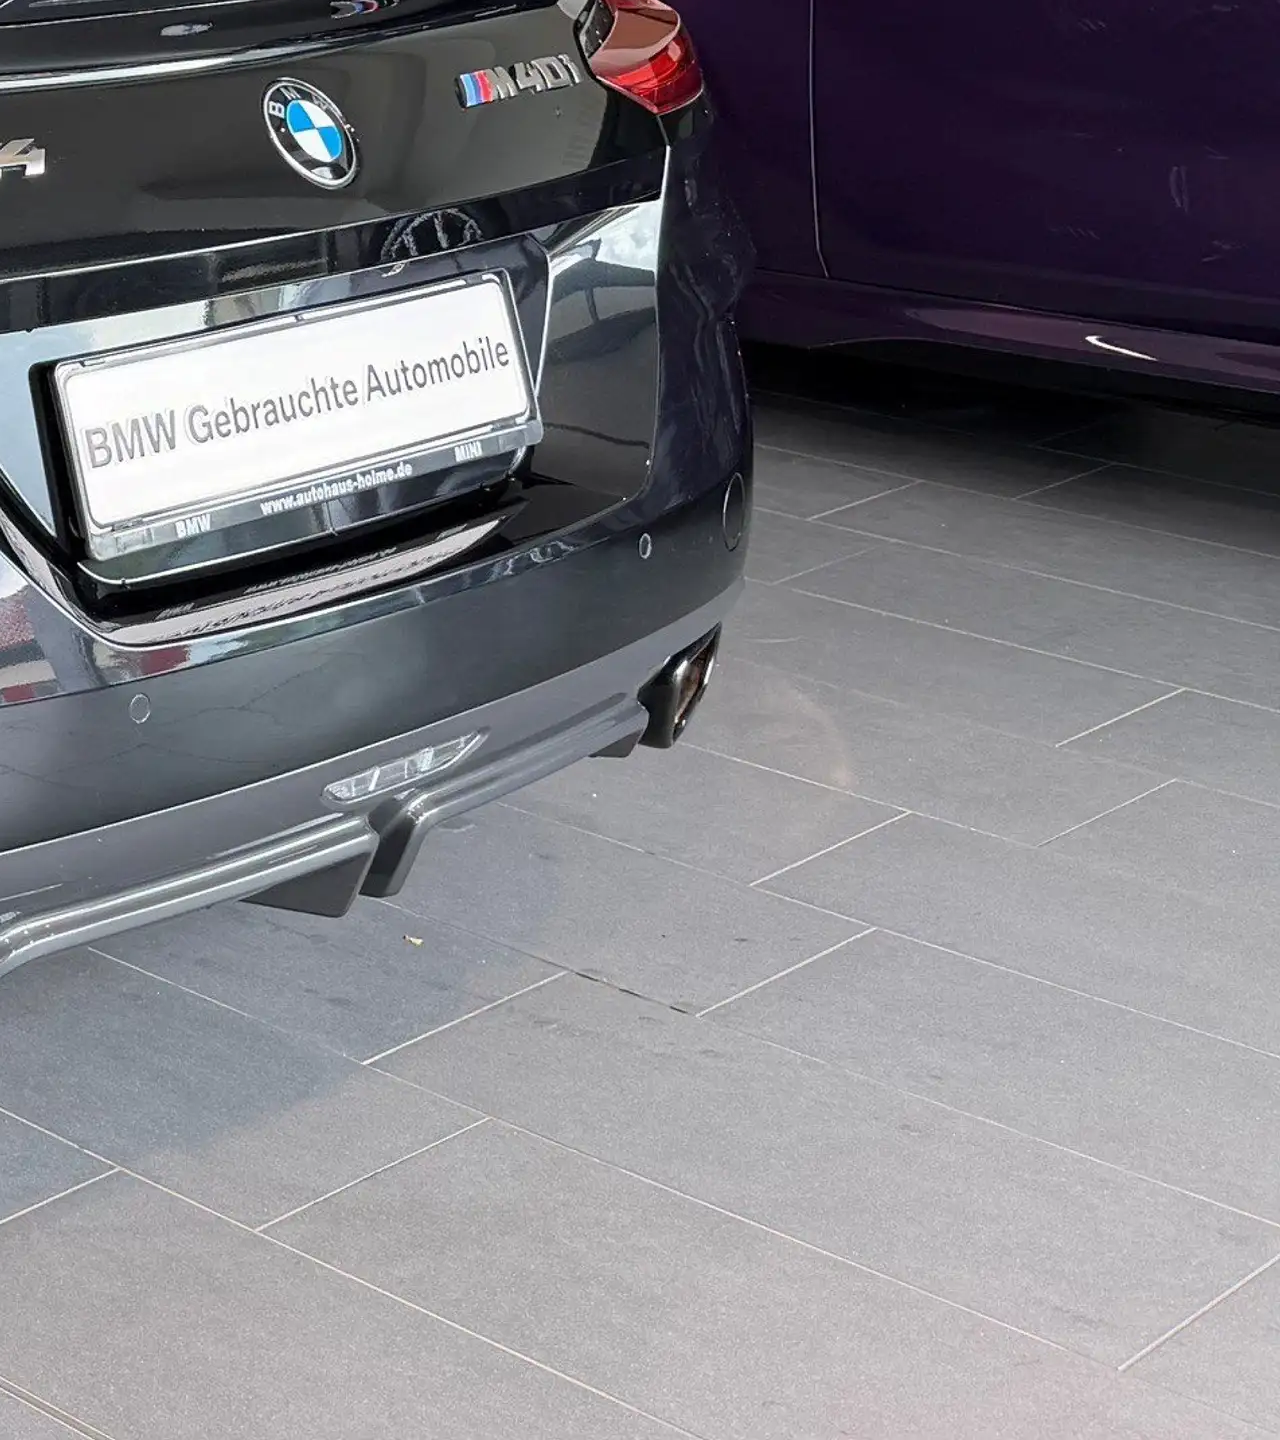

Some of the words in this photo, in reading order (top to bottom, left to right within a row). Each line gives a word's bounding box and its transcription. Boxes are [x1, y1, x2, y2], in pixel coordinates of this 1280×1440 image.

[483, 53, 583, 102] M40i
[268, 84, 332, 119] BMW
[83, 407, 177, 469] BMW
[186, 376, 359, 444] Gebrauchte
[364, 335, 510, 403] Automobile
[454, 443, 483, 463] MINI
[259, 462, 414, 516] www.autohaus-holme.de
[174, 514, 212, 539] BMW
